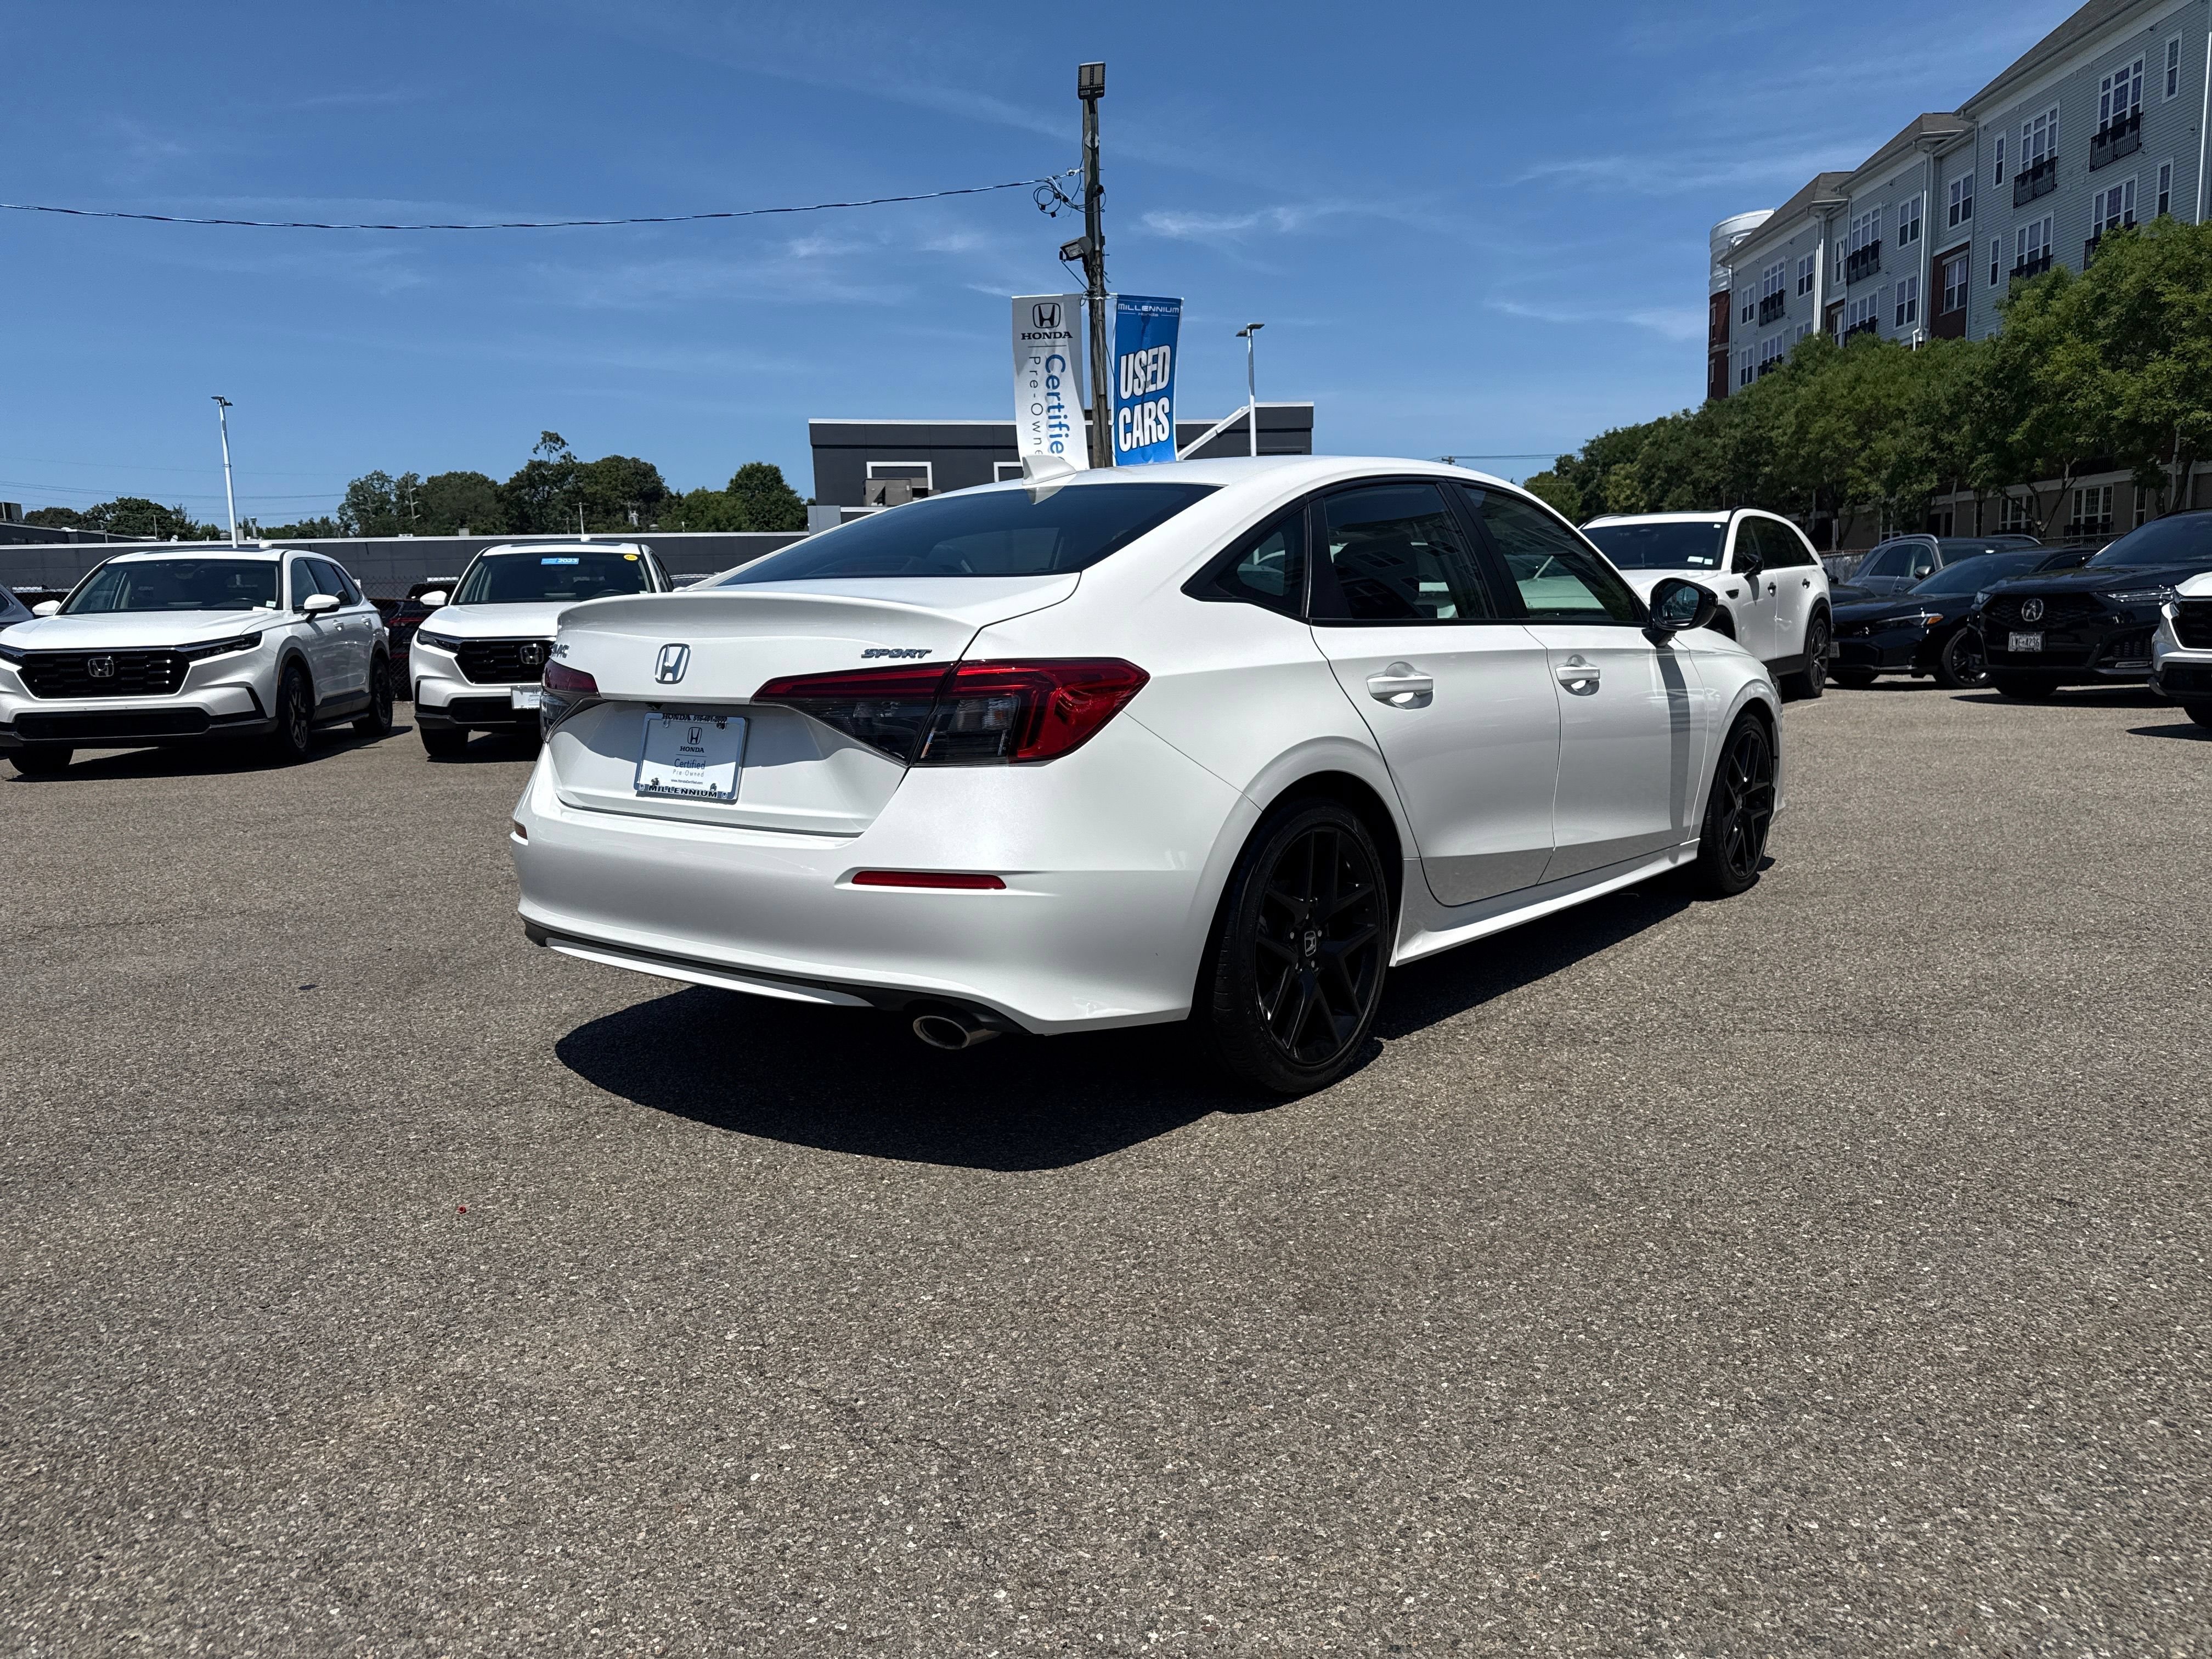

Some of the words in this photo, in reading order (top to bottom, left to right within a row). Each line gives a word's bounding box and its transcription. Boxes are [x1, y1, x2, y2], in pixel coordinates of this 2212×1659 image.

[1118, 303, 1180, 313] MILLENNIUM
[1021, 331, 1073, 340] HONDA
[1120, 345, 1171, 399] USED
[1029, 356, 1043, 455] Pre-Owne
[1045, 354, 1070, 461] Certifie
[1118, 397, 1170, 452] CARS
[2025, 637, 2040, 647] 4236
[861, 648, 932, 658] SPORT
[662, 713, 691, 721] HONDA
[674, 758, 706, 770] Certified
[648, 785, 717, 798] MILLENNIUM
